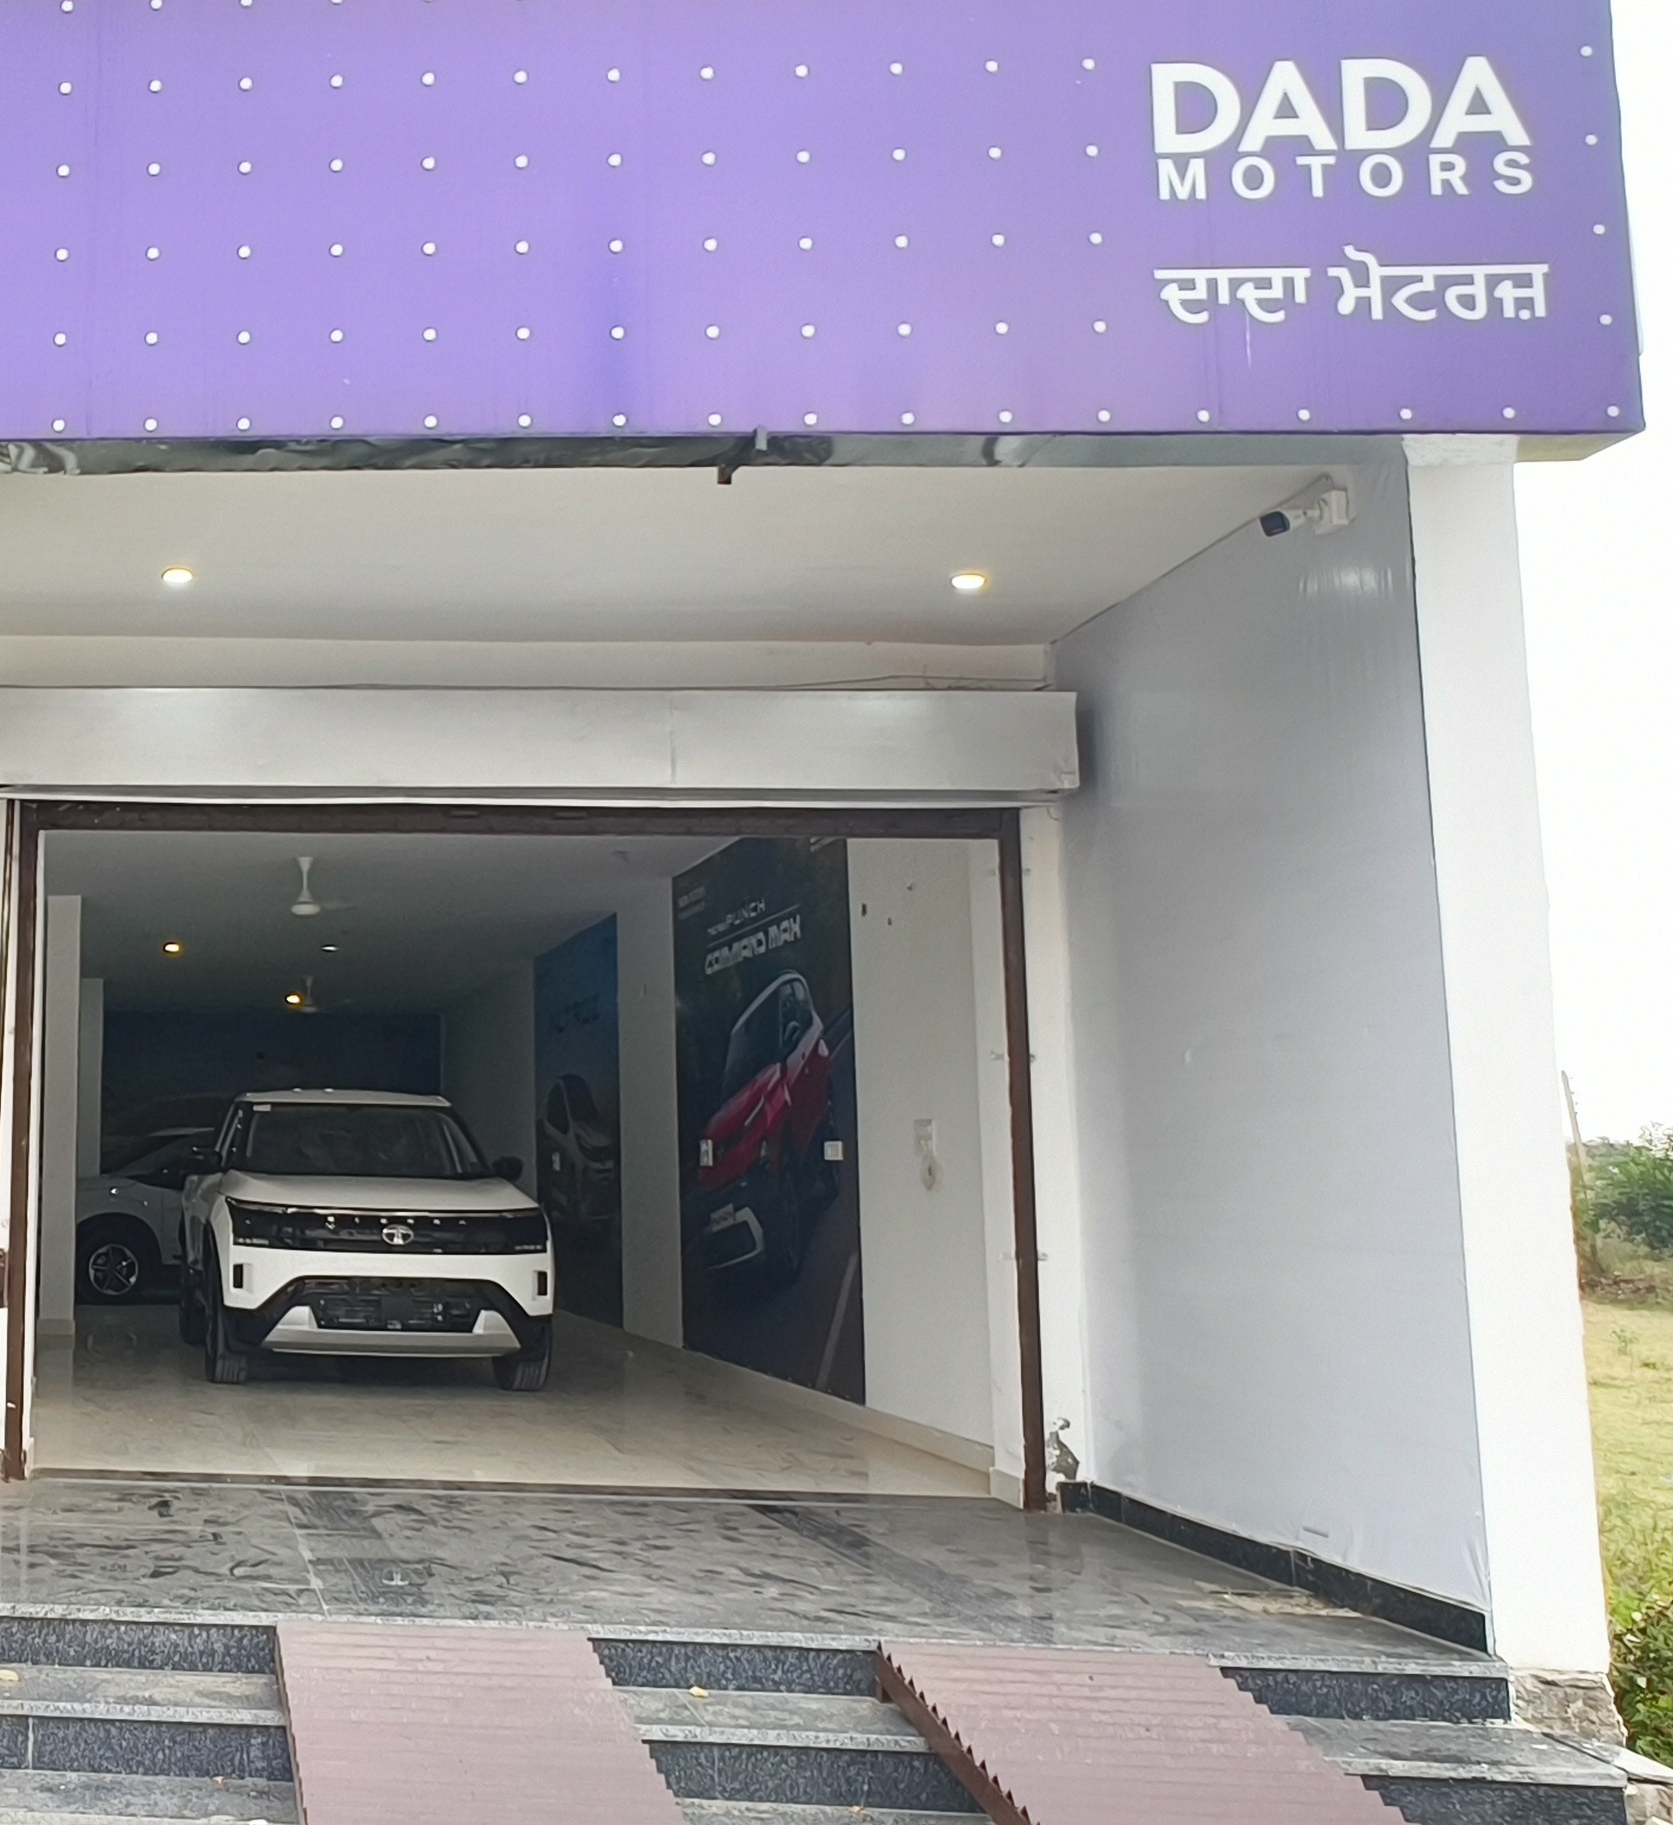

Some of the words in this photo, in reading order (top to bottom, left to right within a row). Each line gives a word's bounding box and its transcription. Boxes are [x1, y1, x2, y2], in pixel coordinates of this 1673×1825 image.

[1150, 56, 1532, 153] DADA
[1157, 152, 1533, 200] MOTORS
[1153, 267, 1311, 324] ਦਾਦਾ
[1327, 245, 1549, 321] ਮੋਟਰਜ਼
